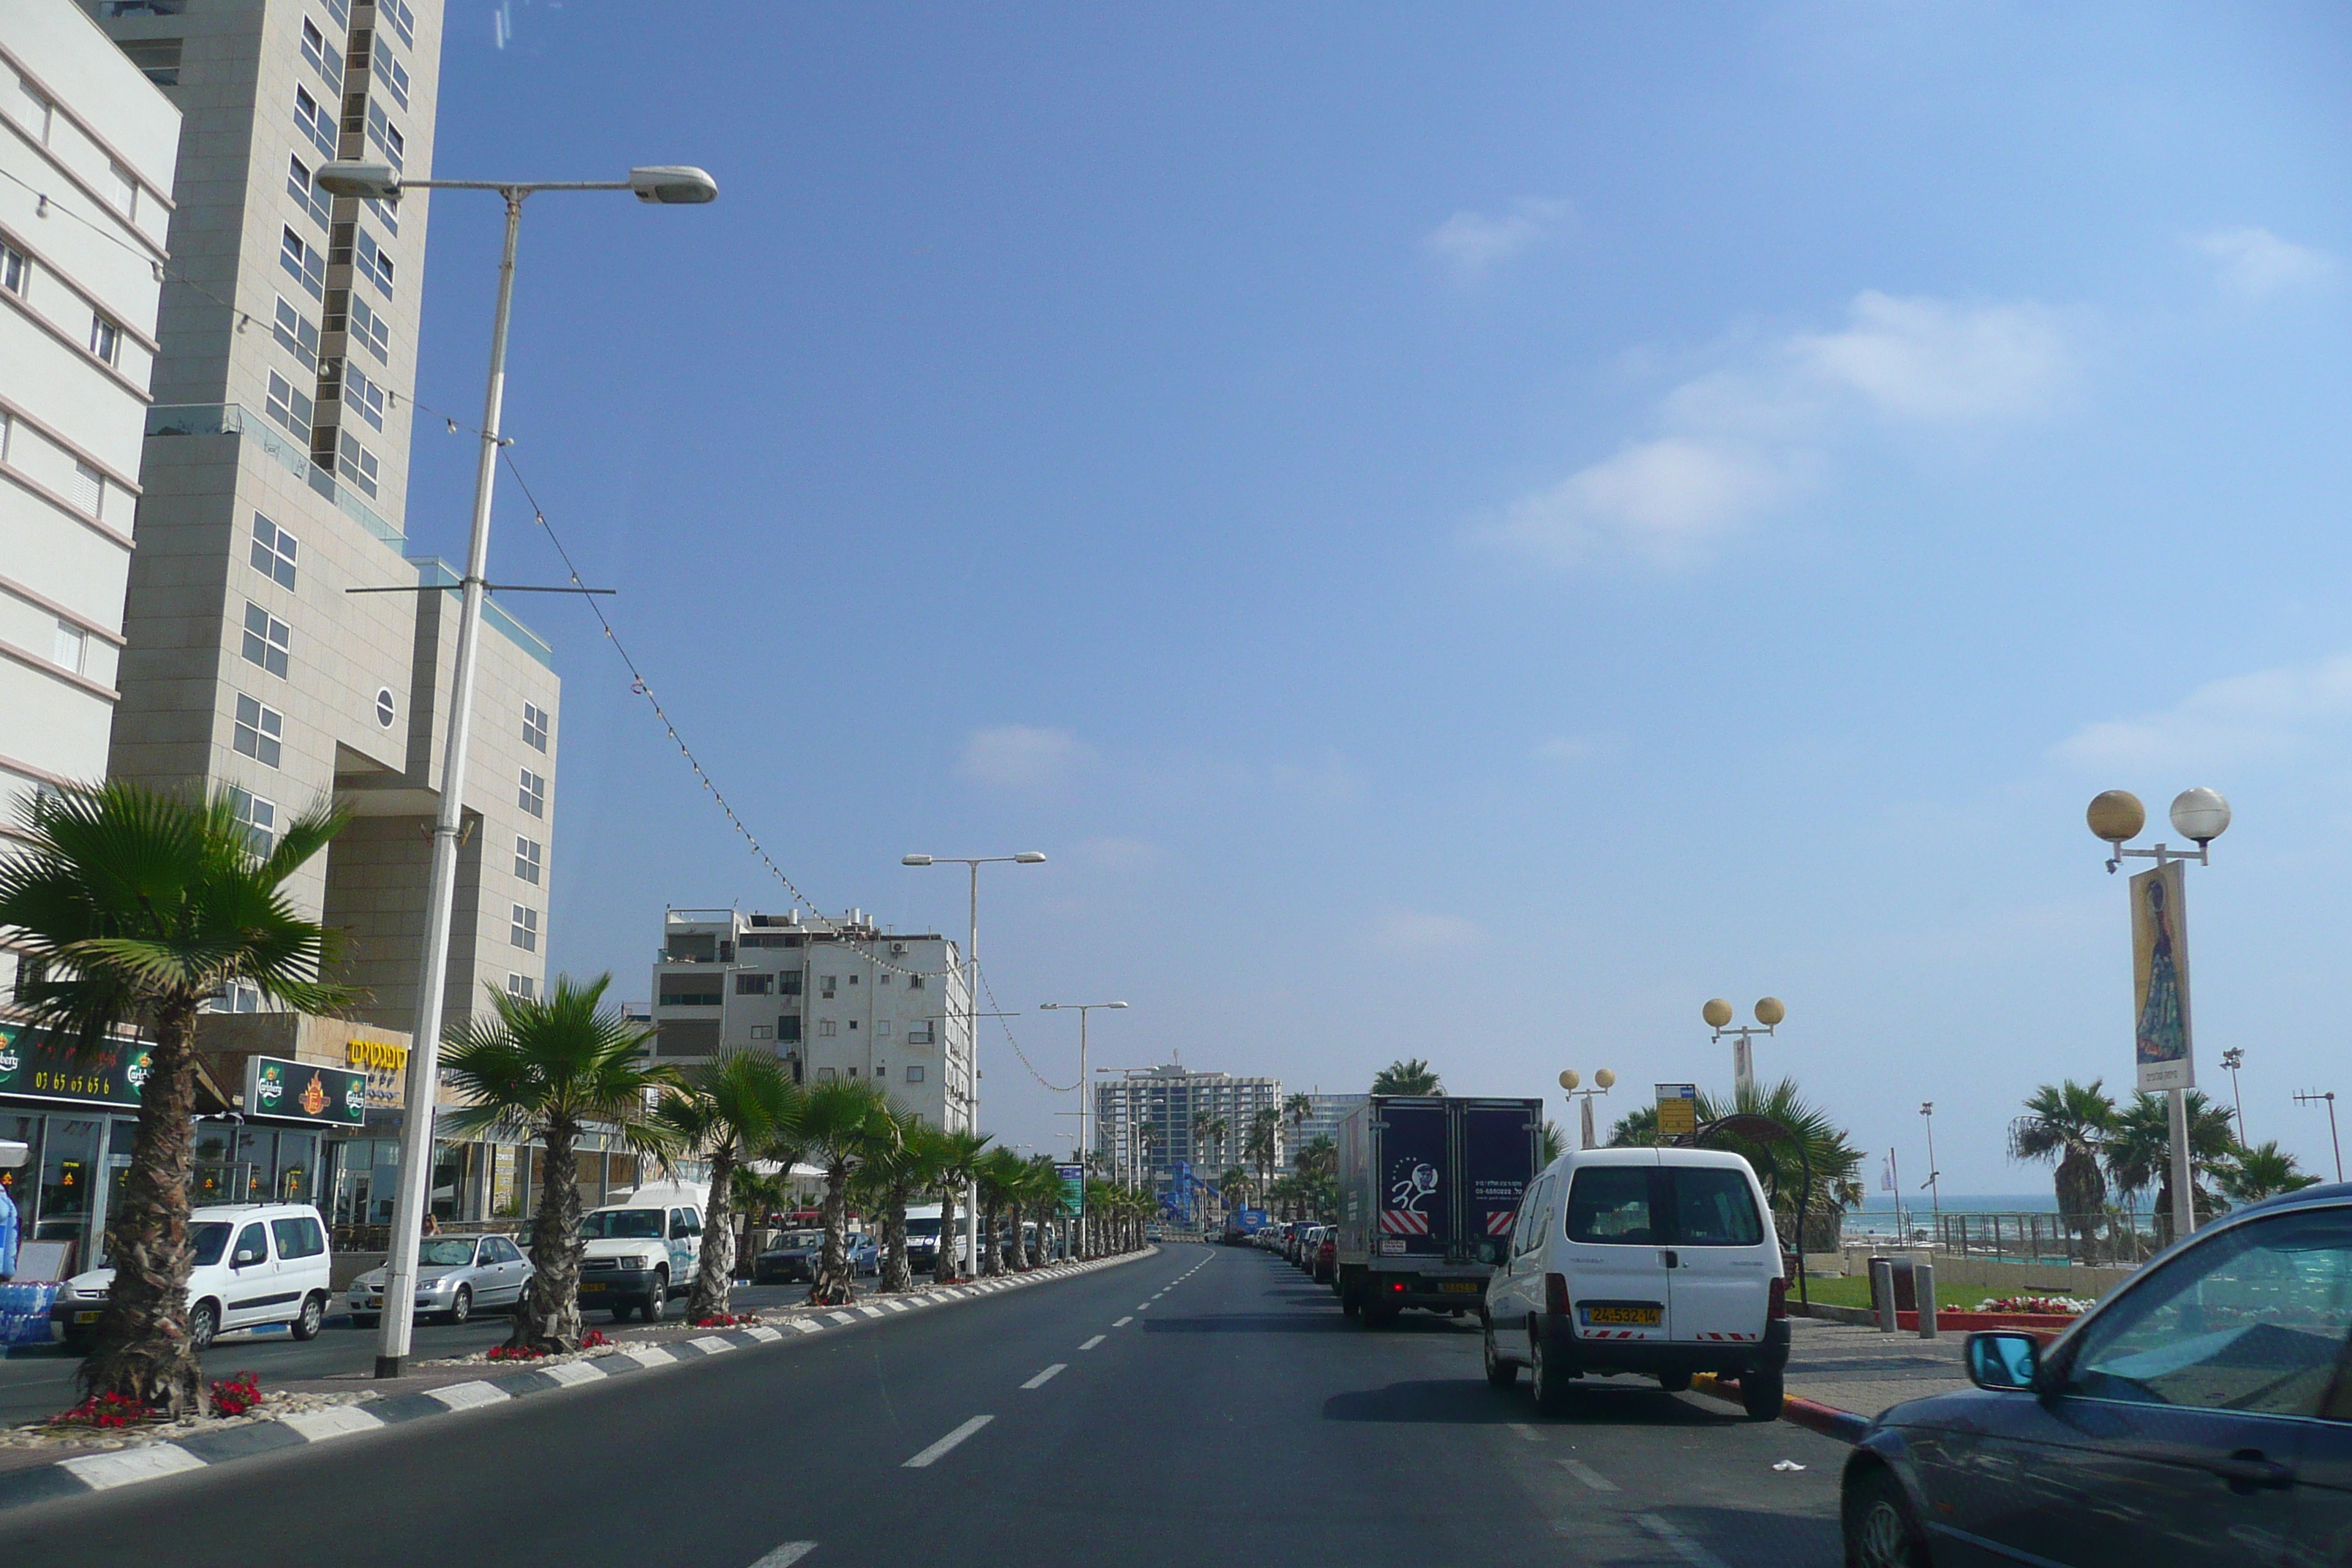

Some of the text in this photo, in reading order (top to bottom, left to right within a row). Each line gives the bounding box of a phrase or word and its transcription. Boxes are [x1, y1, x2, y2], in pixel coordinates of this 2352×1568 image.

[36, 1071, 48, 1090] 03
[53, 1072, 66, 1091] 65
[87, 1076, 99, 1095] 65
[104, 1077, 109, 1095] 6
[258, 1077, 283, 1098] Carlsberg
[346, 1090, 364, 1109] Carlsberg
